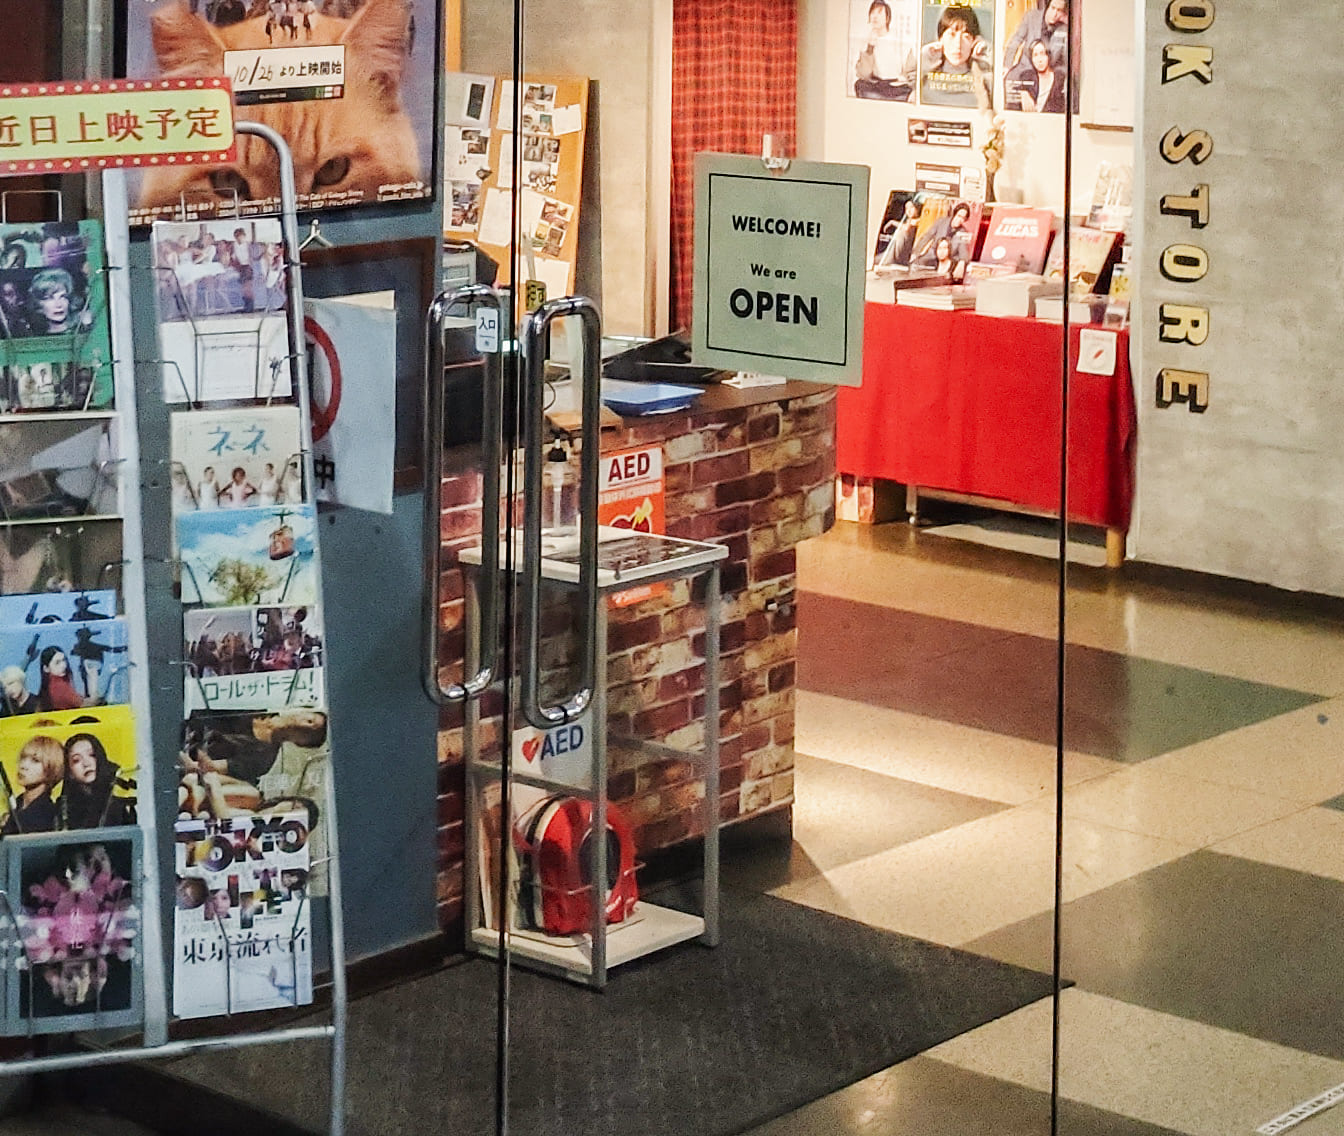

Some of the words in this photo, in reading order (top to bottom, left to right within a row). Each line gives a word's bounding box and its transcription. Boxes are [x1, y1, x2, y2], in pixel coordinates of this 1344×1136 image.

[278, 60, 343, 78] より上映開始
[731, 214, 822, 239] WELCOME!
[750, 262, 770, 278] We
[774, 266, 798, 281] are
[1155, 125, 1213, 414] STORE
[729, 287, 819, 327] OPEN
[478, 316, 496, 331] 入口
[608, 452, 650, 482] AED
[540, 724, 585, 760] AED
